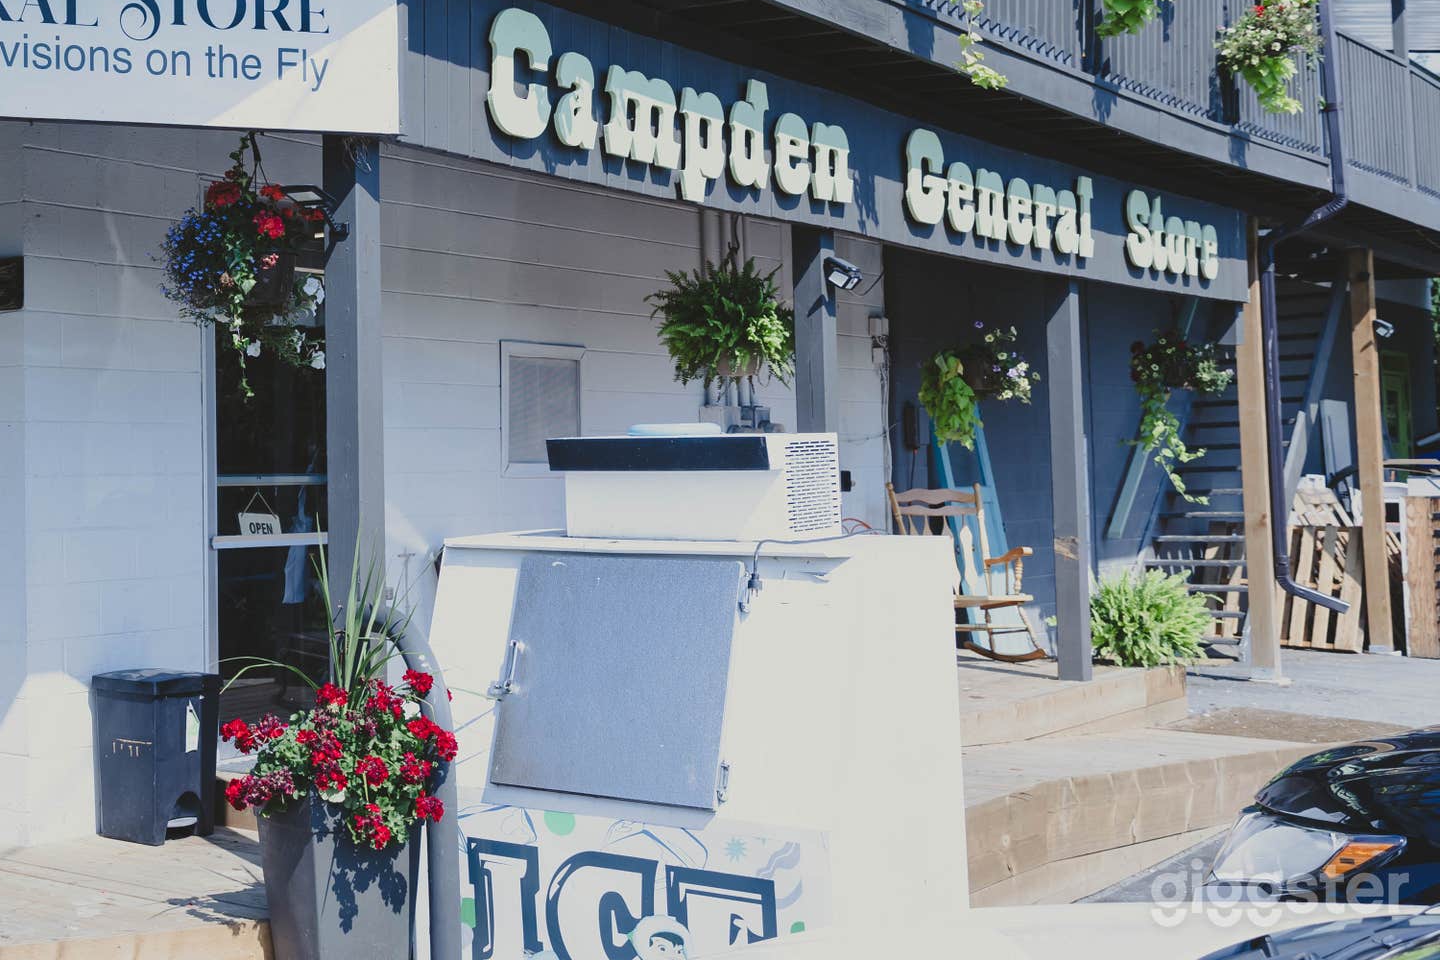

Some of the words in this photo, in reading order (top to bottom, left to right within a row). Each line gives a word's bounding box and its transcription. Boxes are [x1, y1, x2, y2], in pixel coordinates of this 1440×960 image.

[145, 48, 193, 77] on
[205, 43, 263, 81] the
[276, 48, 330, 92] Fly
[486, 7, 854, 204] Campden
[904, 128, 1095, 259] General
[1123, 189, 1221, 282] Store
[249, 522, 274, 535] OPEN
